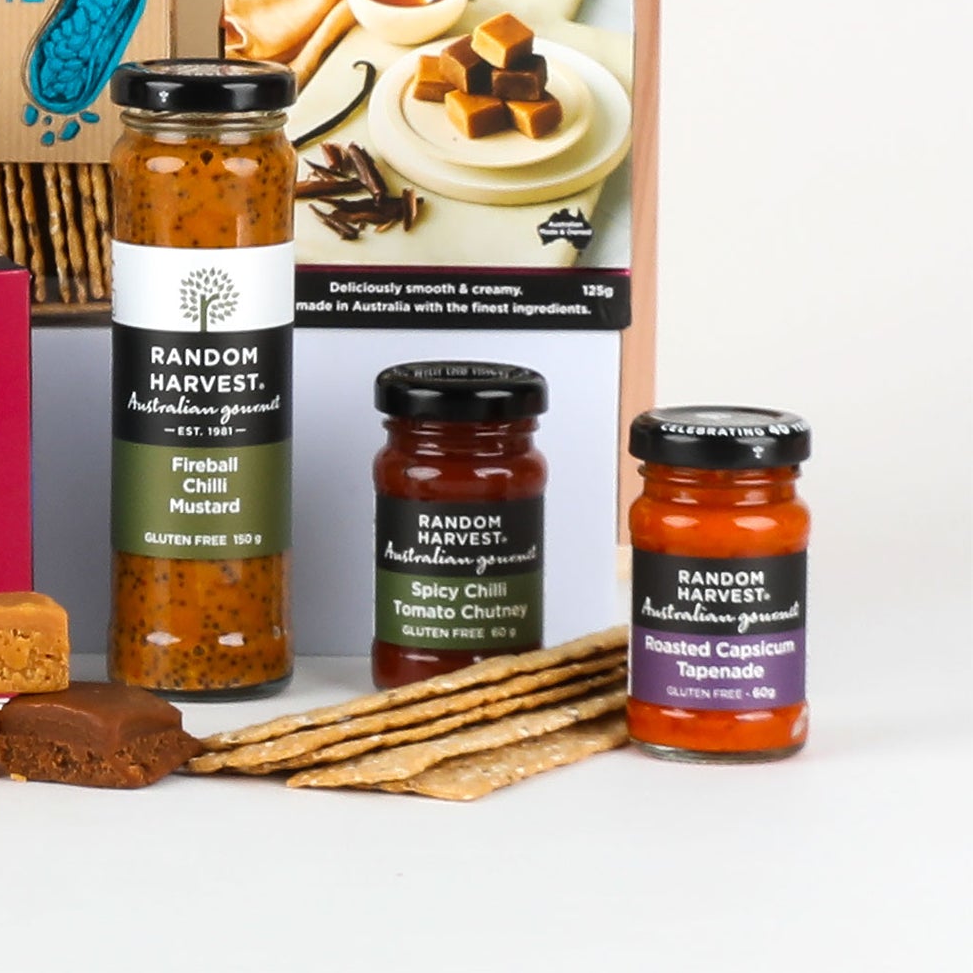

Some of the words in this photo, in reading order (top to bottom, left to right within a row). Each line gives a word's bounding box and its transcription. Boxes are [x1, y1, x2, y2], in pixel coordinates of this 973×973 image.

[330, 281, 402, 296] Deliciously
[405, 283, 455, 295] smooth
[459, 283, 468, 295] &
[471, 285, 524, 298] creamy.
[582, 284, 614, 299] 125g
[295, 300, 333, 312] made
[336, 300, 349, 312] in
[352, 300, 410, 313] Australia
[414, 301, 442, 313] with
[446, 301, 468, 314] the
[472, 302, 509, 314] finest
[512, 302, 592, 316] ingredients.
[151, 346, 258, 366] RANDOM
[127, 391, 218, 415] Australian
[220, 394, 281, 424] gourmet
[177, 426, 203, 436] EST.
[208, 426, 233, 436] 1981
[660, 422, 766, 437] CELEBRATING
[172, 456, 238, 473] Fireball
[183, 478, 227, 493] Chilli
[169, 498, 240, 514] Mustard
[418, 514, 501, 529] RANDOM
[144, 532, 191, 545] GLUTEN
[194, 535, 227, 546] FREE
[233, 534, 252, 545] 150
[254, 535, 262, 545] g
[384, 540, 474, 565] Australian
[476, 545, 538, 575] gourmet
[678, 570, 764, 586] RANDOM
[411, 581, 459, 601] Spicy
[464, 582, 507, 598] Chilli
[393, 599, 456, 619] Tomato
[461, 603, 528, 619] Chutney
[641, 596, 736, 623] Australian
[737, 600, 800, 634] gourmet
[402, 625, 449, 638] GLUTEN
[452, 627, 484, 639] FREE
[491, 627, 506, 637] 60
[509, 628, 516, 638] g
[644, 635, 711, 657] Roasted
[716, 640, 795, 660] Capsicum
[676, 660, 765, 680] Tapenade
[666, 686, 710, 699] GLUTEN
[713, 687, 742, 699] FREE
[752, 686, 776, 699] 60g
